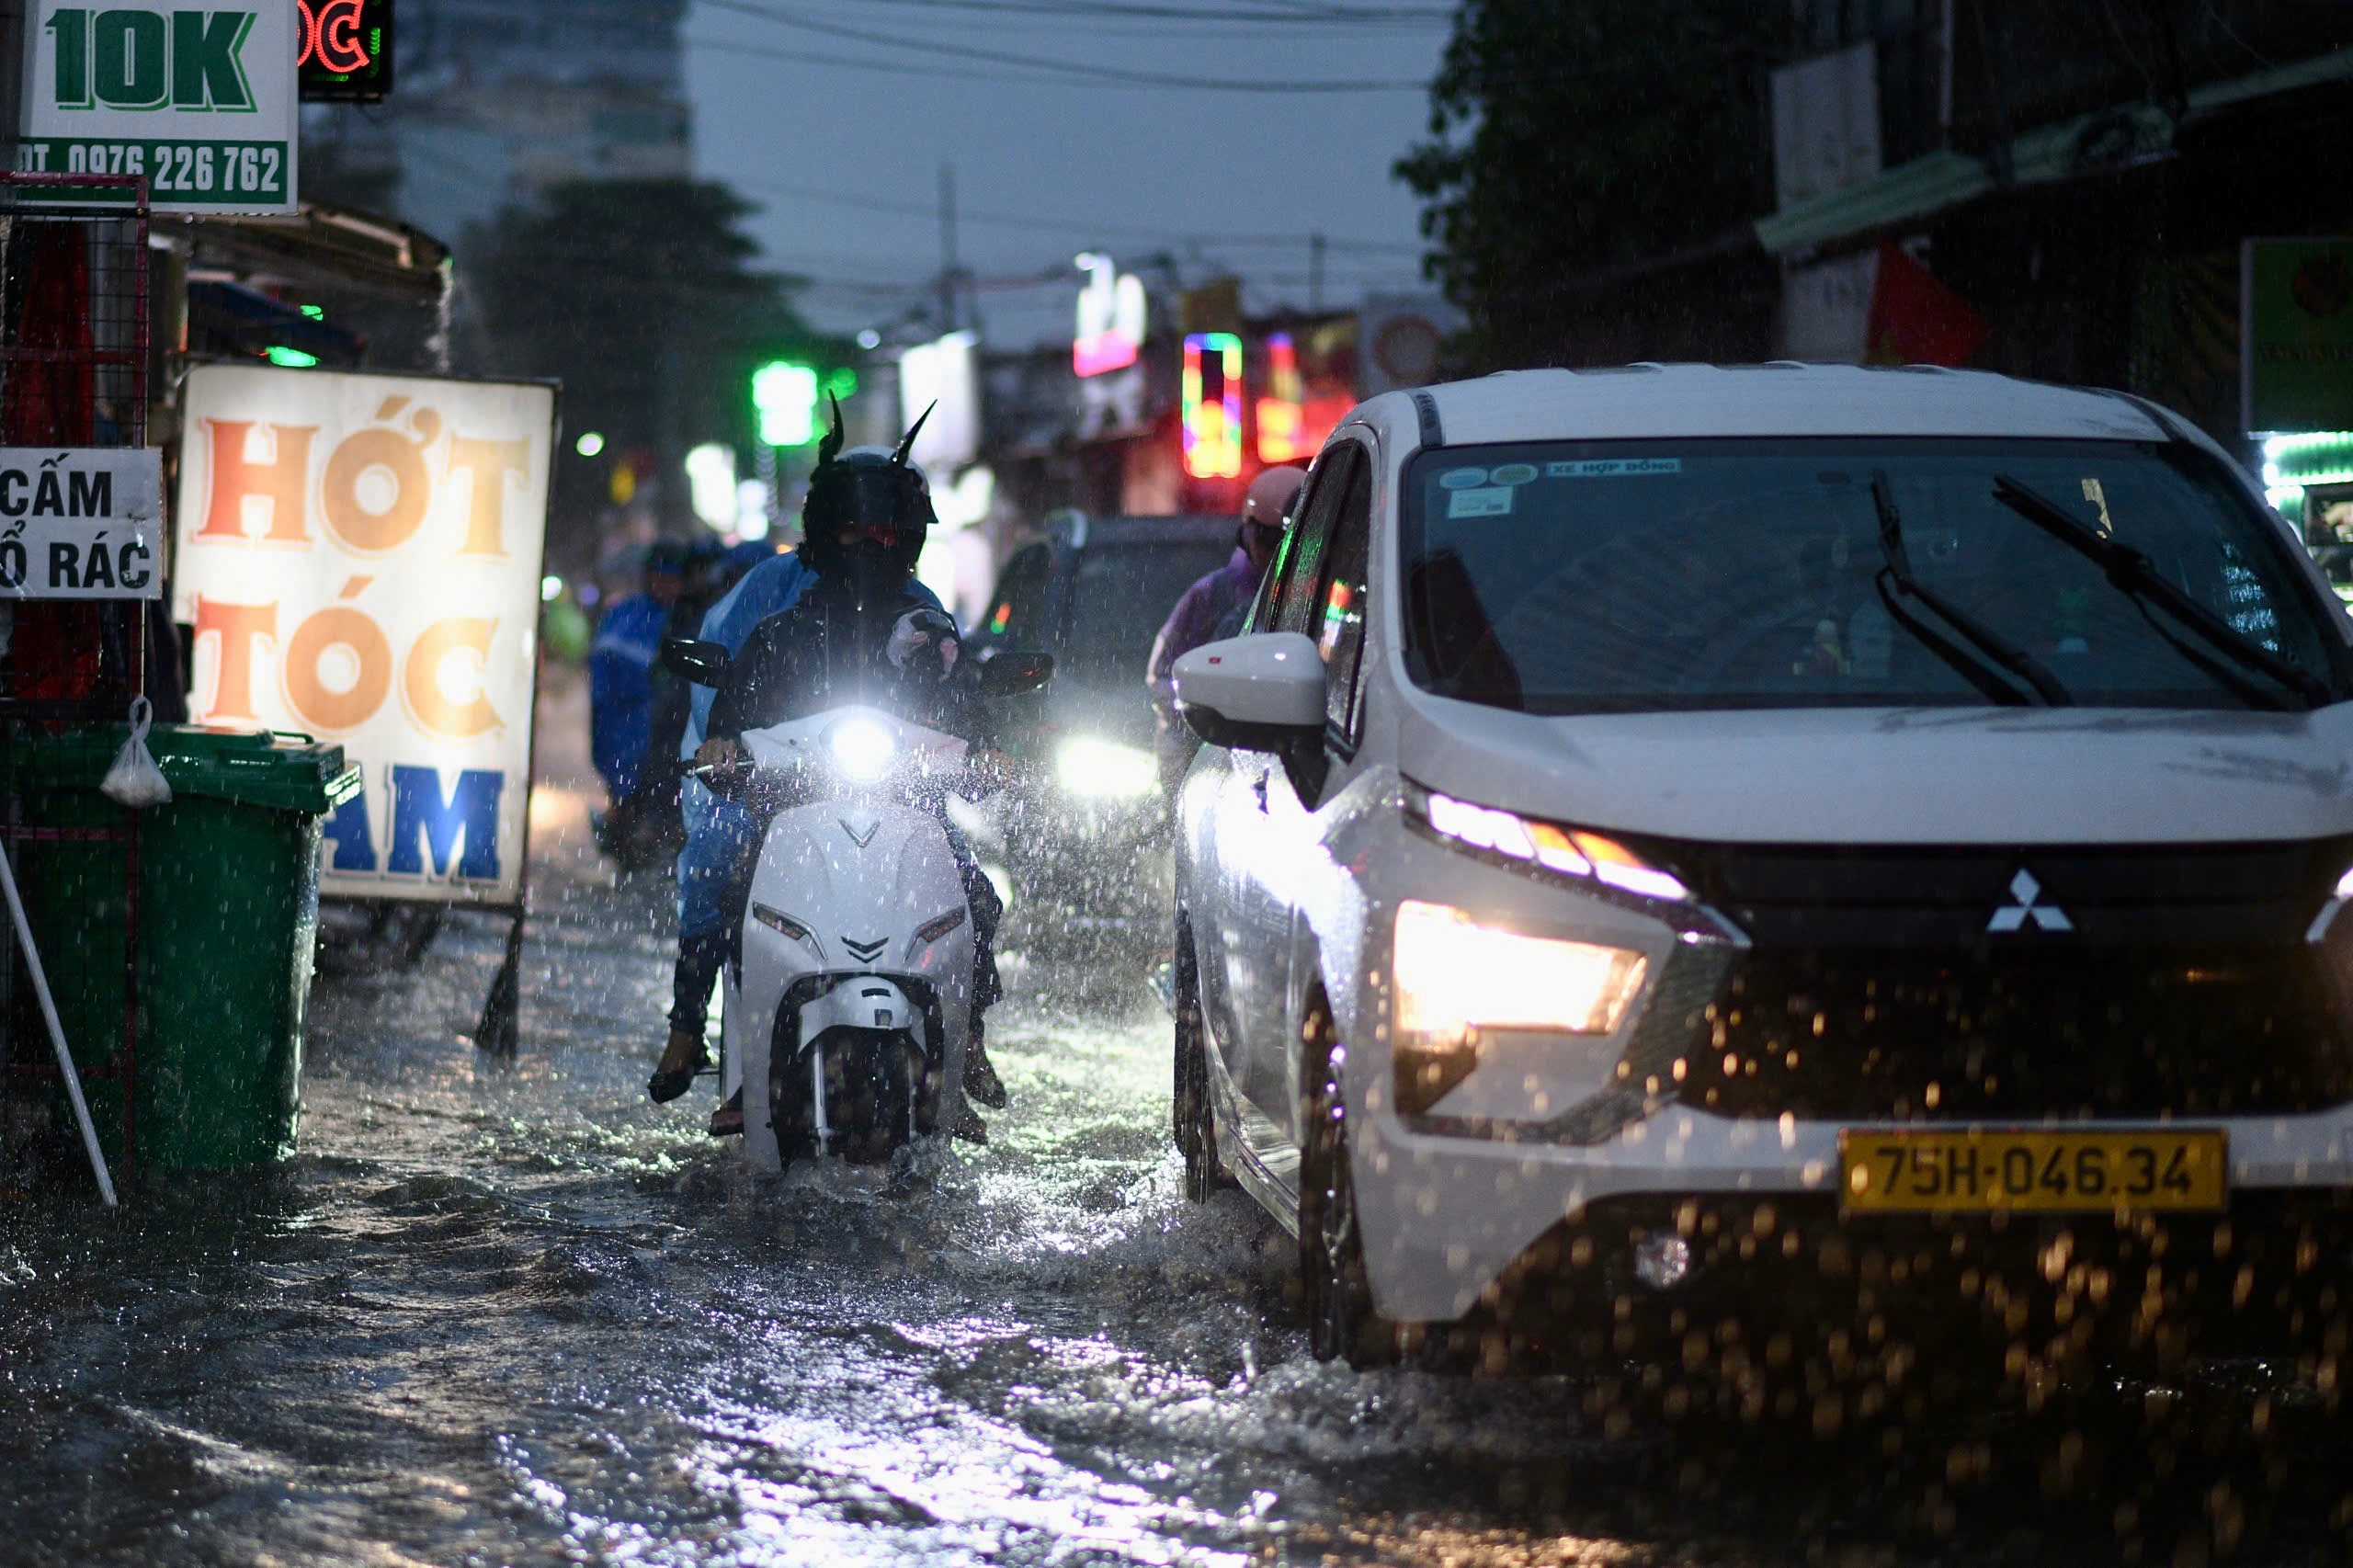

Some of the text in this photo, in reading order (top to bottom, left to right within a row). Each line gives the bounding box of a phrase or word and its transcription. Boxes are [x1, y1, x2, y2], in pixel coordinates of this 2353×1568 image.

[46, 8, 258, 113] 10K
[69, 144, 144, 188] 0976
[154, 146, 213, 191] 226
[223, 147, 279, 191] 762
[0, 453, 112, 517] CẤM
[190, 395, 531, 559] HỚT
[49, 530, 150, 589] RÁC
[192, 574, 506, 740] TÓC
[1875, 1146, 2192, 1196] 75H-046.34
